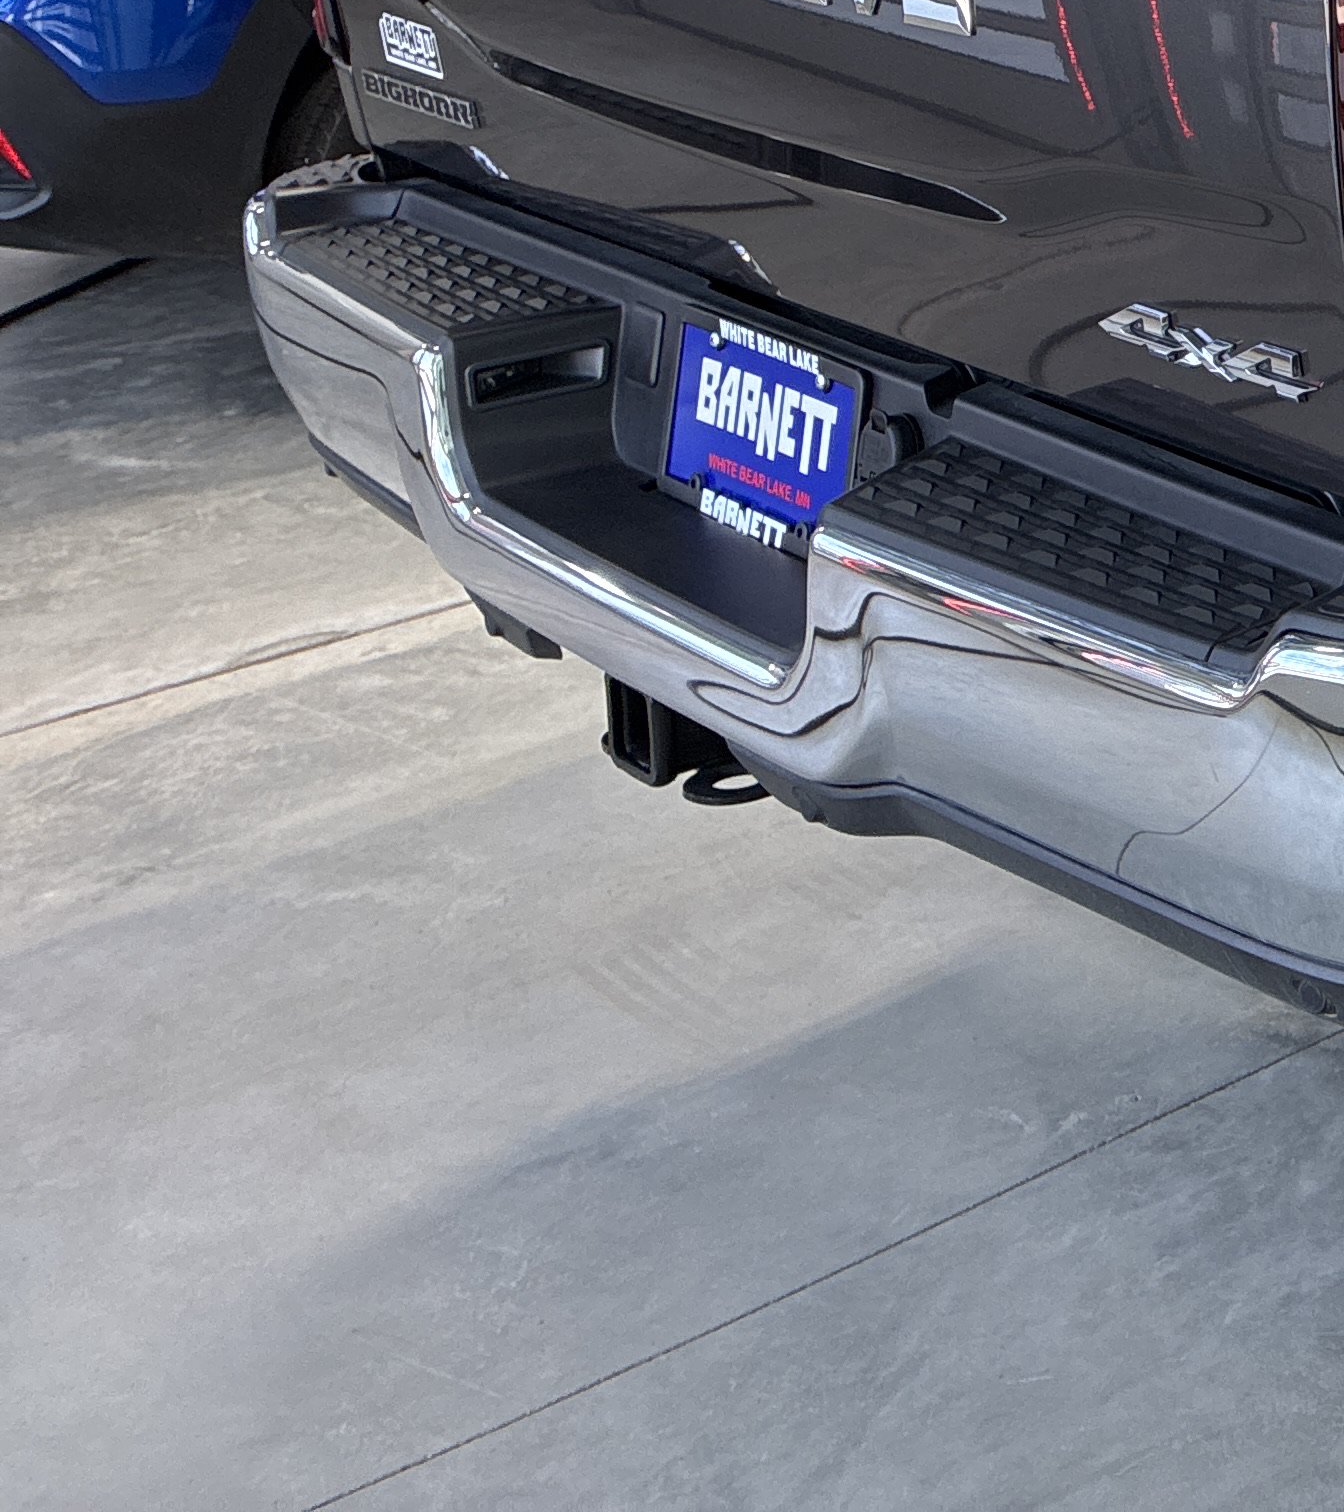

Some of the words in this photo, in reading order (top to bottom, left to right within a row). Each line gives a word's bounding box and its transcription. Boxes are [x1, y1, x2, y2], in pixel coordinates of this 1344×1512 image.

[718, 318, 756, 351] WHITE
[756, 332, 788, 364] BEAR
[788, 345, 820, 375] LAKE
[695, 356, 838, 476] BARNETT
[707, 452, 738, 480] WHITE
[738, 464, 767, 492] BEAR
[795, 489, 812, 510] MN
[699, 487, 788, 549] BARNETT
